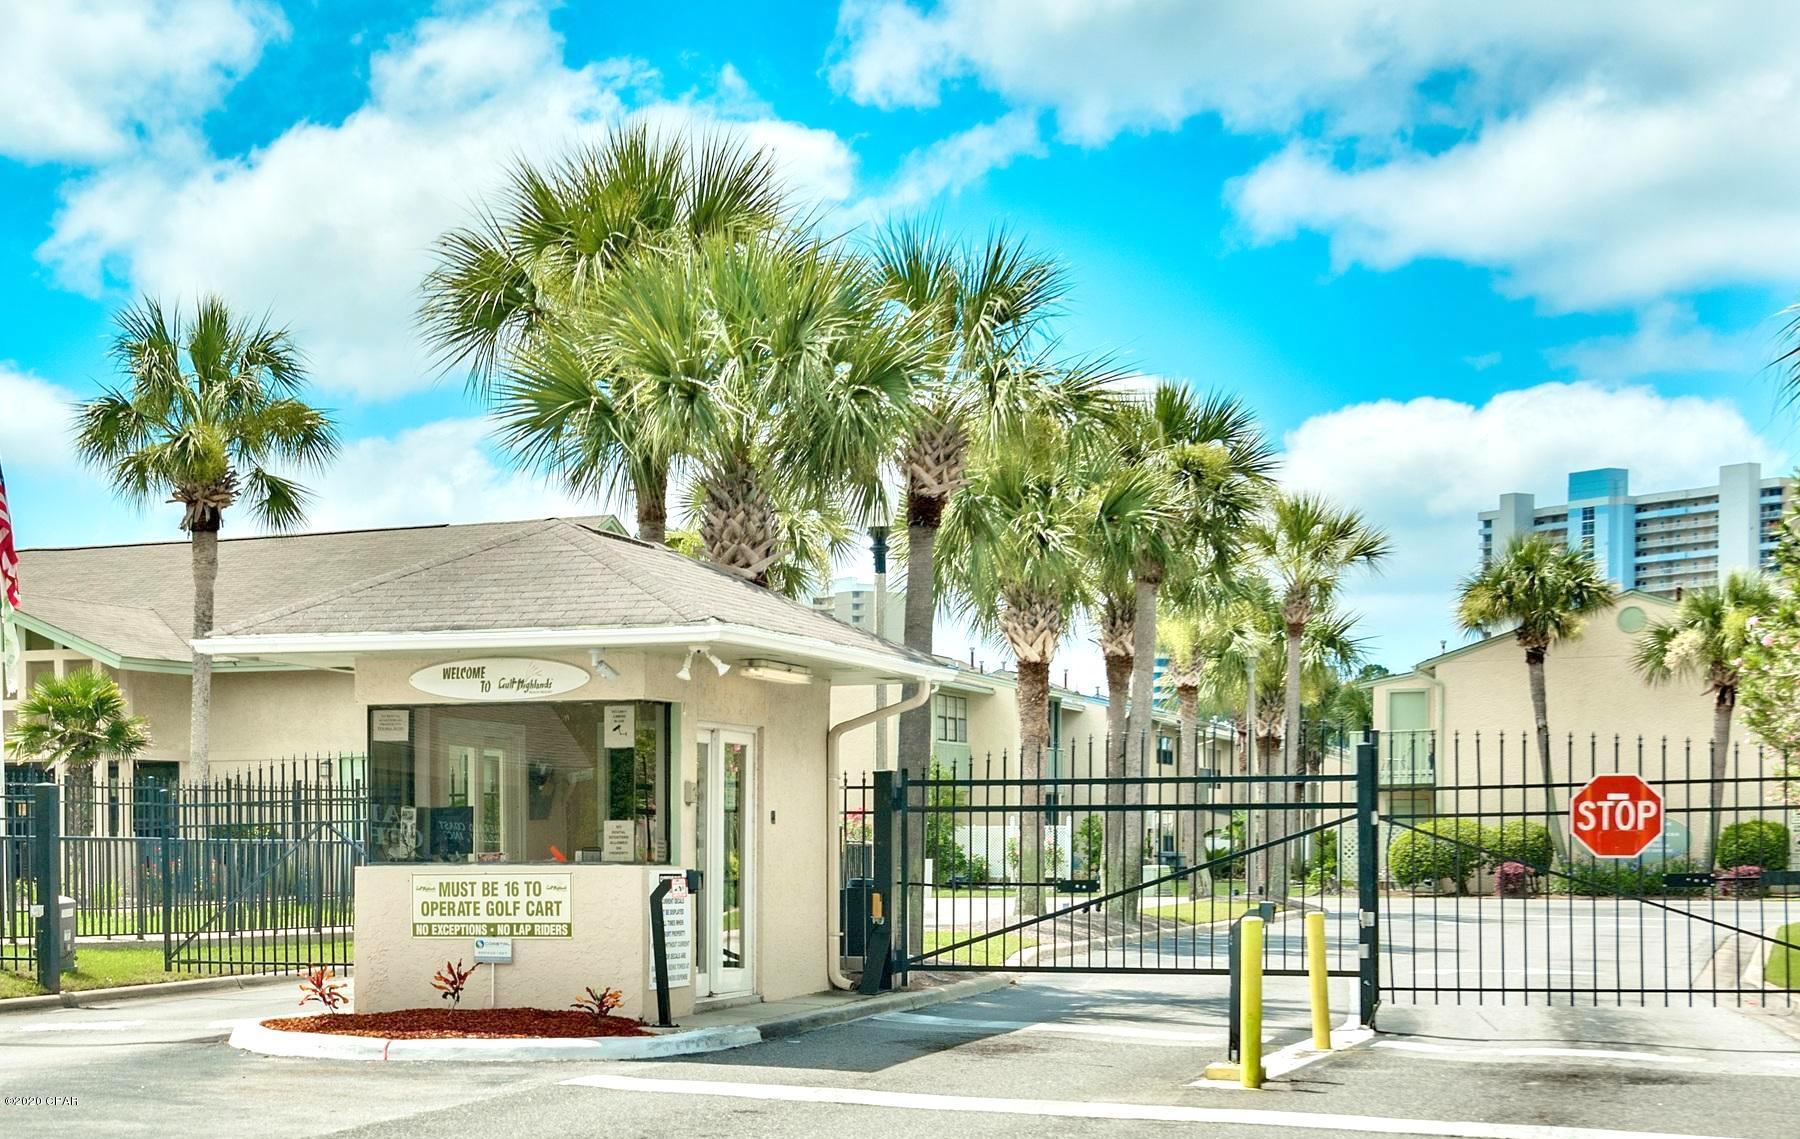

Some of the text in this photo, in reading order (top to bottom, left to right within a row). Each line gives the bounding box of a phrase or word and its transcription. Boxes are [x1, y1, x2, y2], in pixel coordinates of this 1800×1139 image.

[442, 666, 486, 680] WELCOME
[480, 680, 491, 693] TO
[516, 677, 553, 693] Highlands
[1576, 800, 1658, 831] STOP
[438, 881, 477, 897] MUST
[482, 881, 499, 897] BE
[504, 881, 519, 897] 16
[524, 880, 542, 897] TO
[421, 900, 562, 917] OPERATE GOLF CART
[415, 924, 568, 936] NO EXCEPTIONS NO LAP RIDERS
